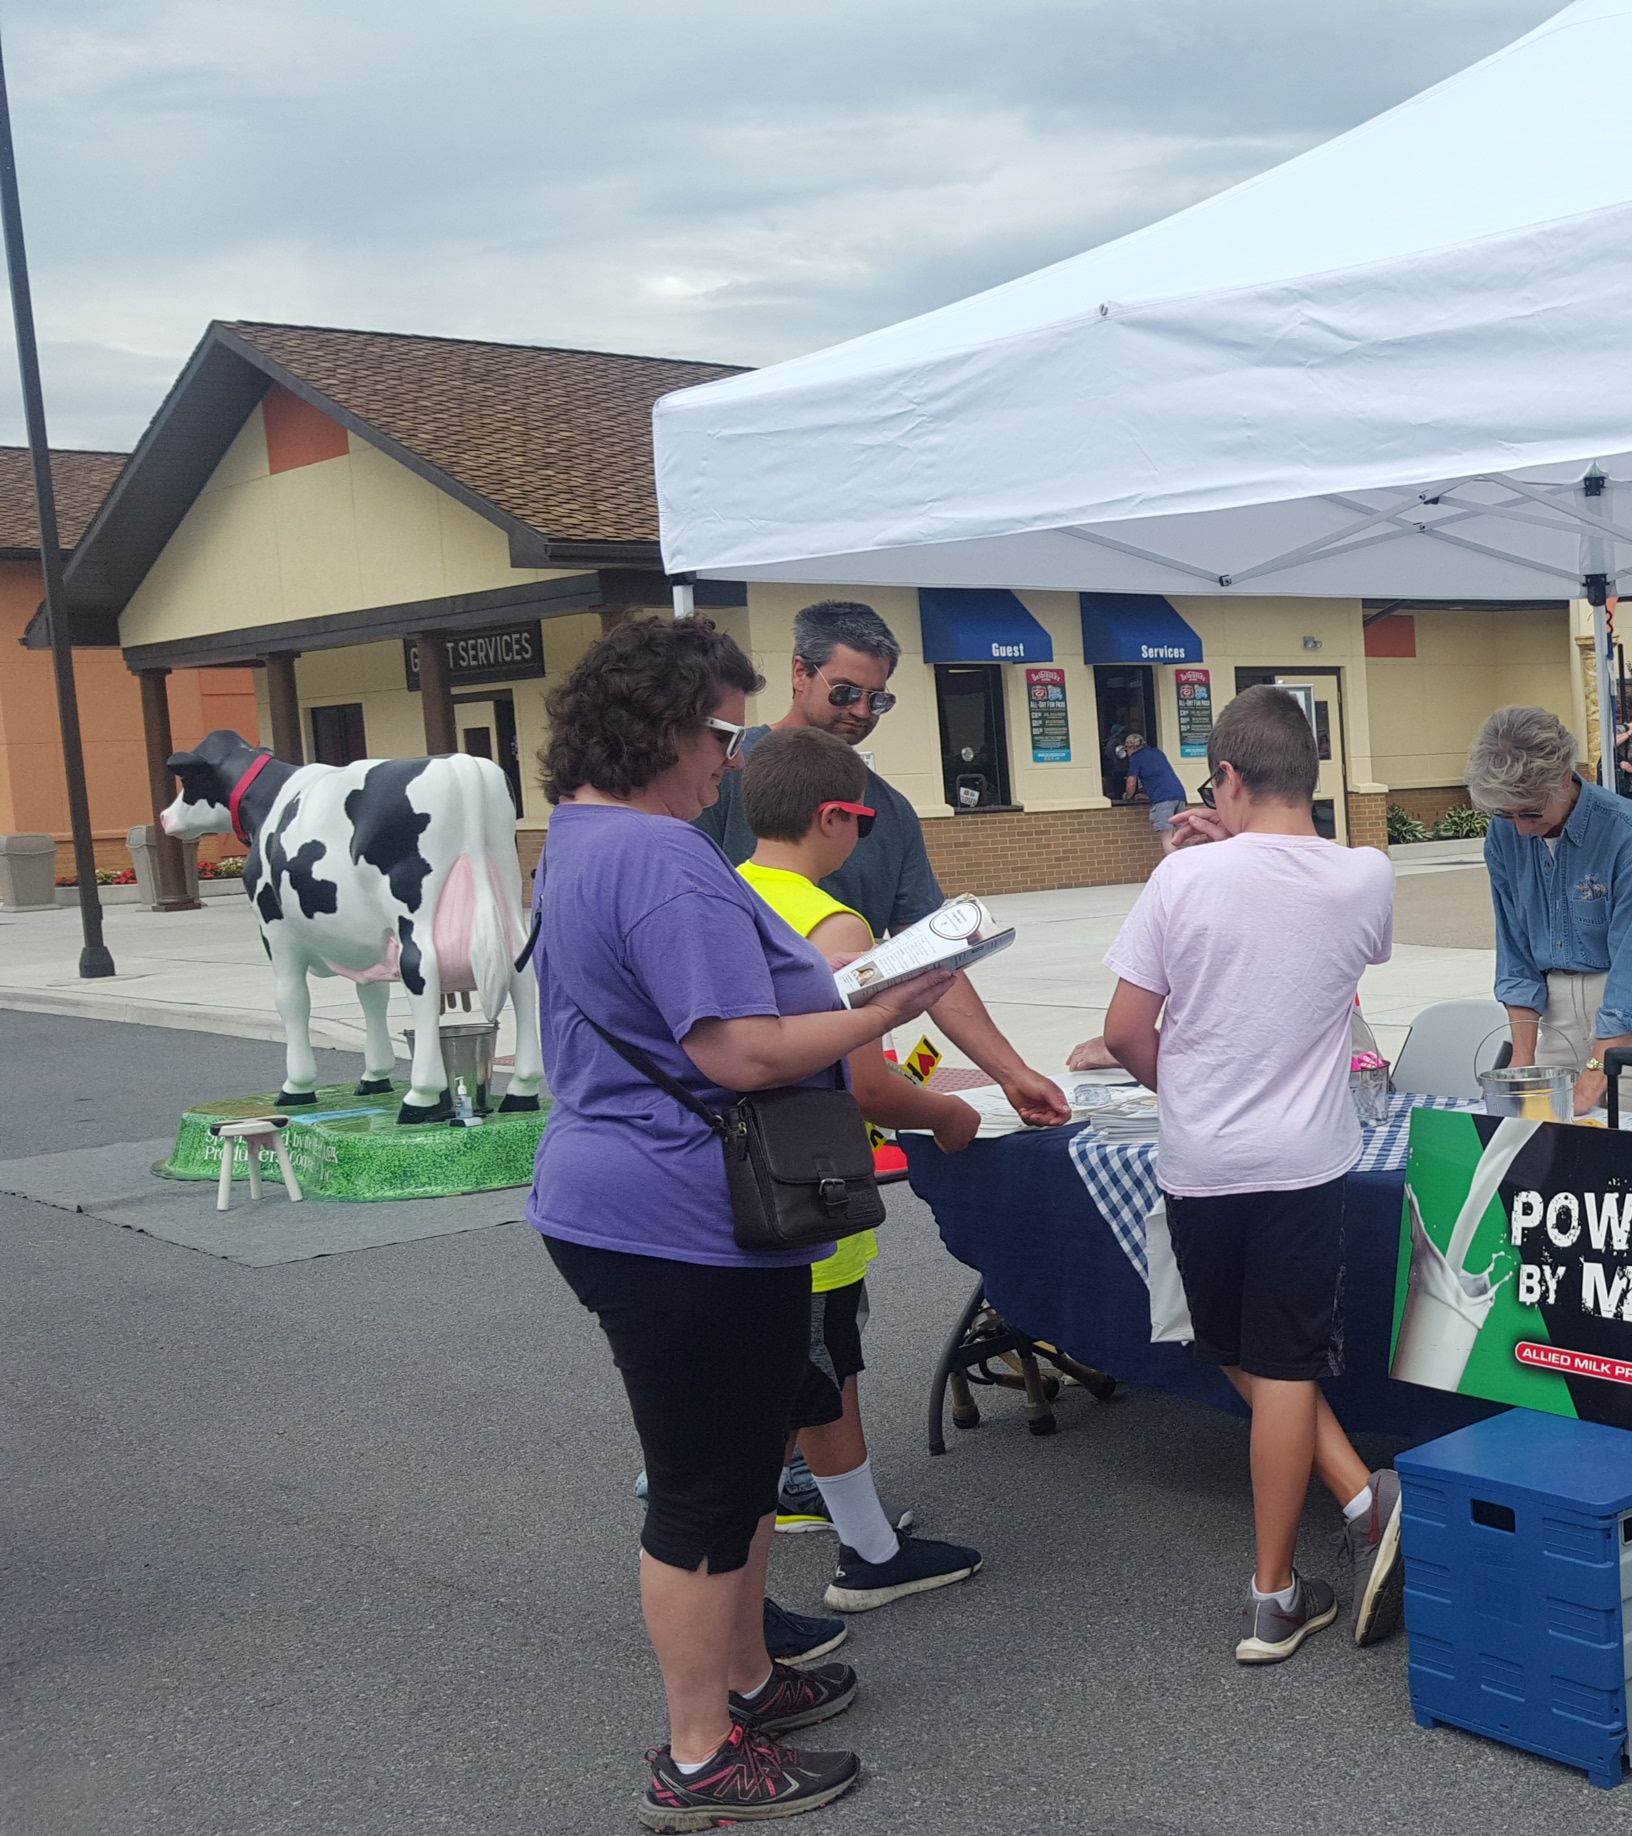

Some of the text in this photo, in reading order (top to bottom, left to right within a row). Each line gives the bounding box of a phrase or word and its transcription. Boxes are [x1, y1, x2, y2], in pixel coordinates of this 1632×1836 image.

[458, 632, 532, 667] SERVICES
[992, 642, 1025, 657] Guest
[1141, 644, 1185, 659] Services
[1518, 1263, 1566, 1304] BY
[1521, 1346, 1570, 1366] ALLIED
[1574, 1358, 1611, 1375] MILK
